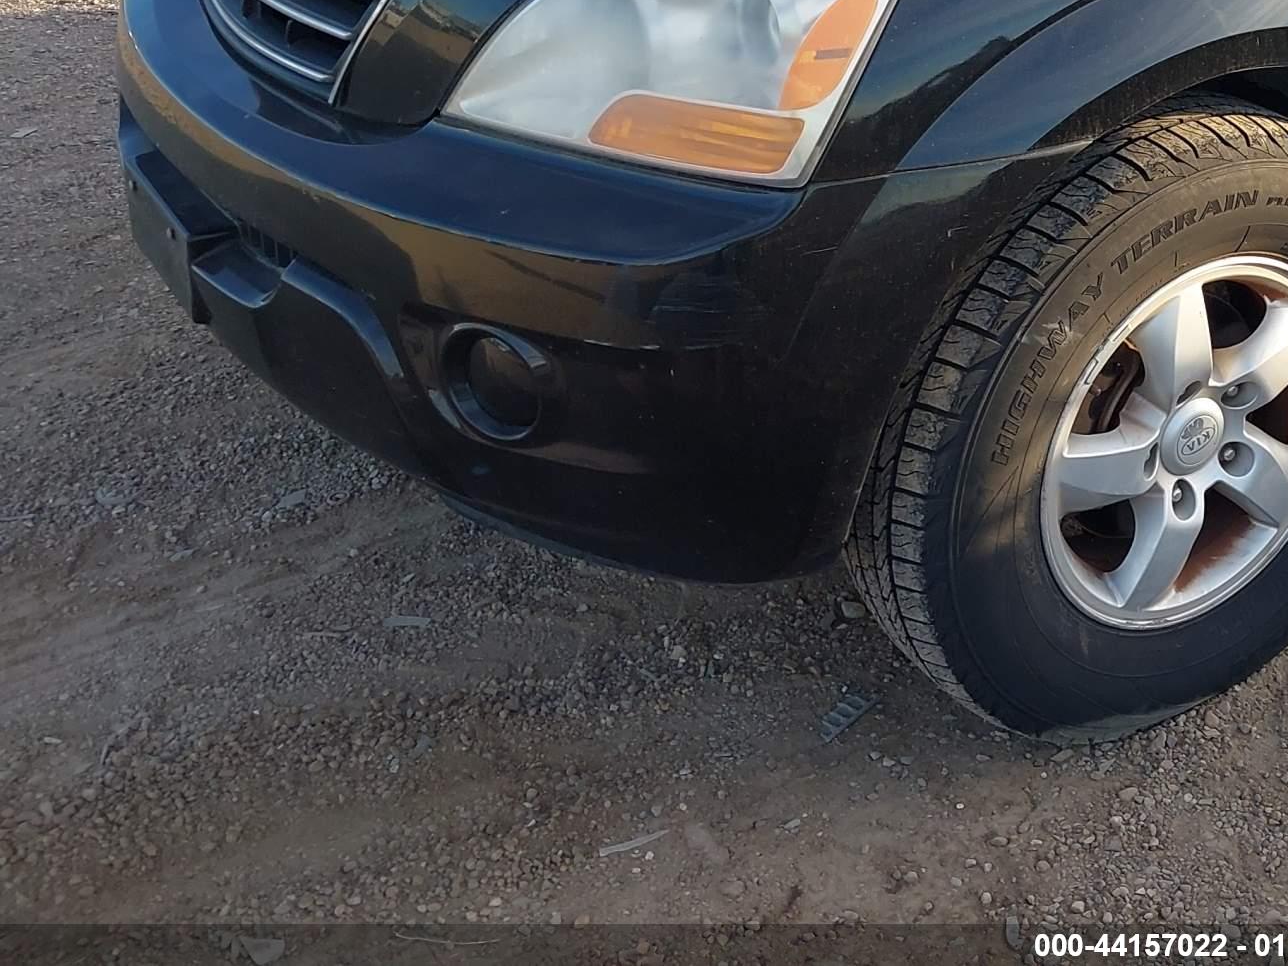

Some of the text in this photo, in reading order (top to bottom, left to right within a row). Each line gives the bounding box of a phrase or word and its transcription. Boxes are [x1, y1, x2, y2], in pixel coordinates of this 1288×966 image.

[991, 272, 1103, 466] HIGHWAY
[1111, 189, 1259, 275] TERRAIN
[1187, 431, 1211, 451] KIA
